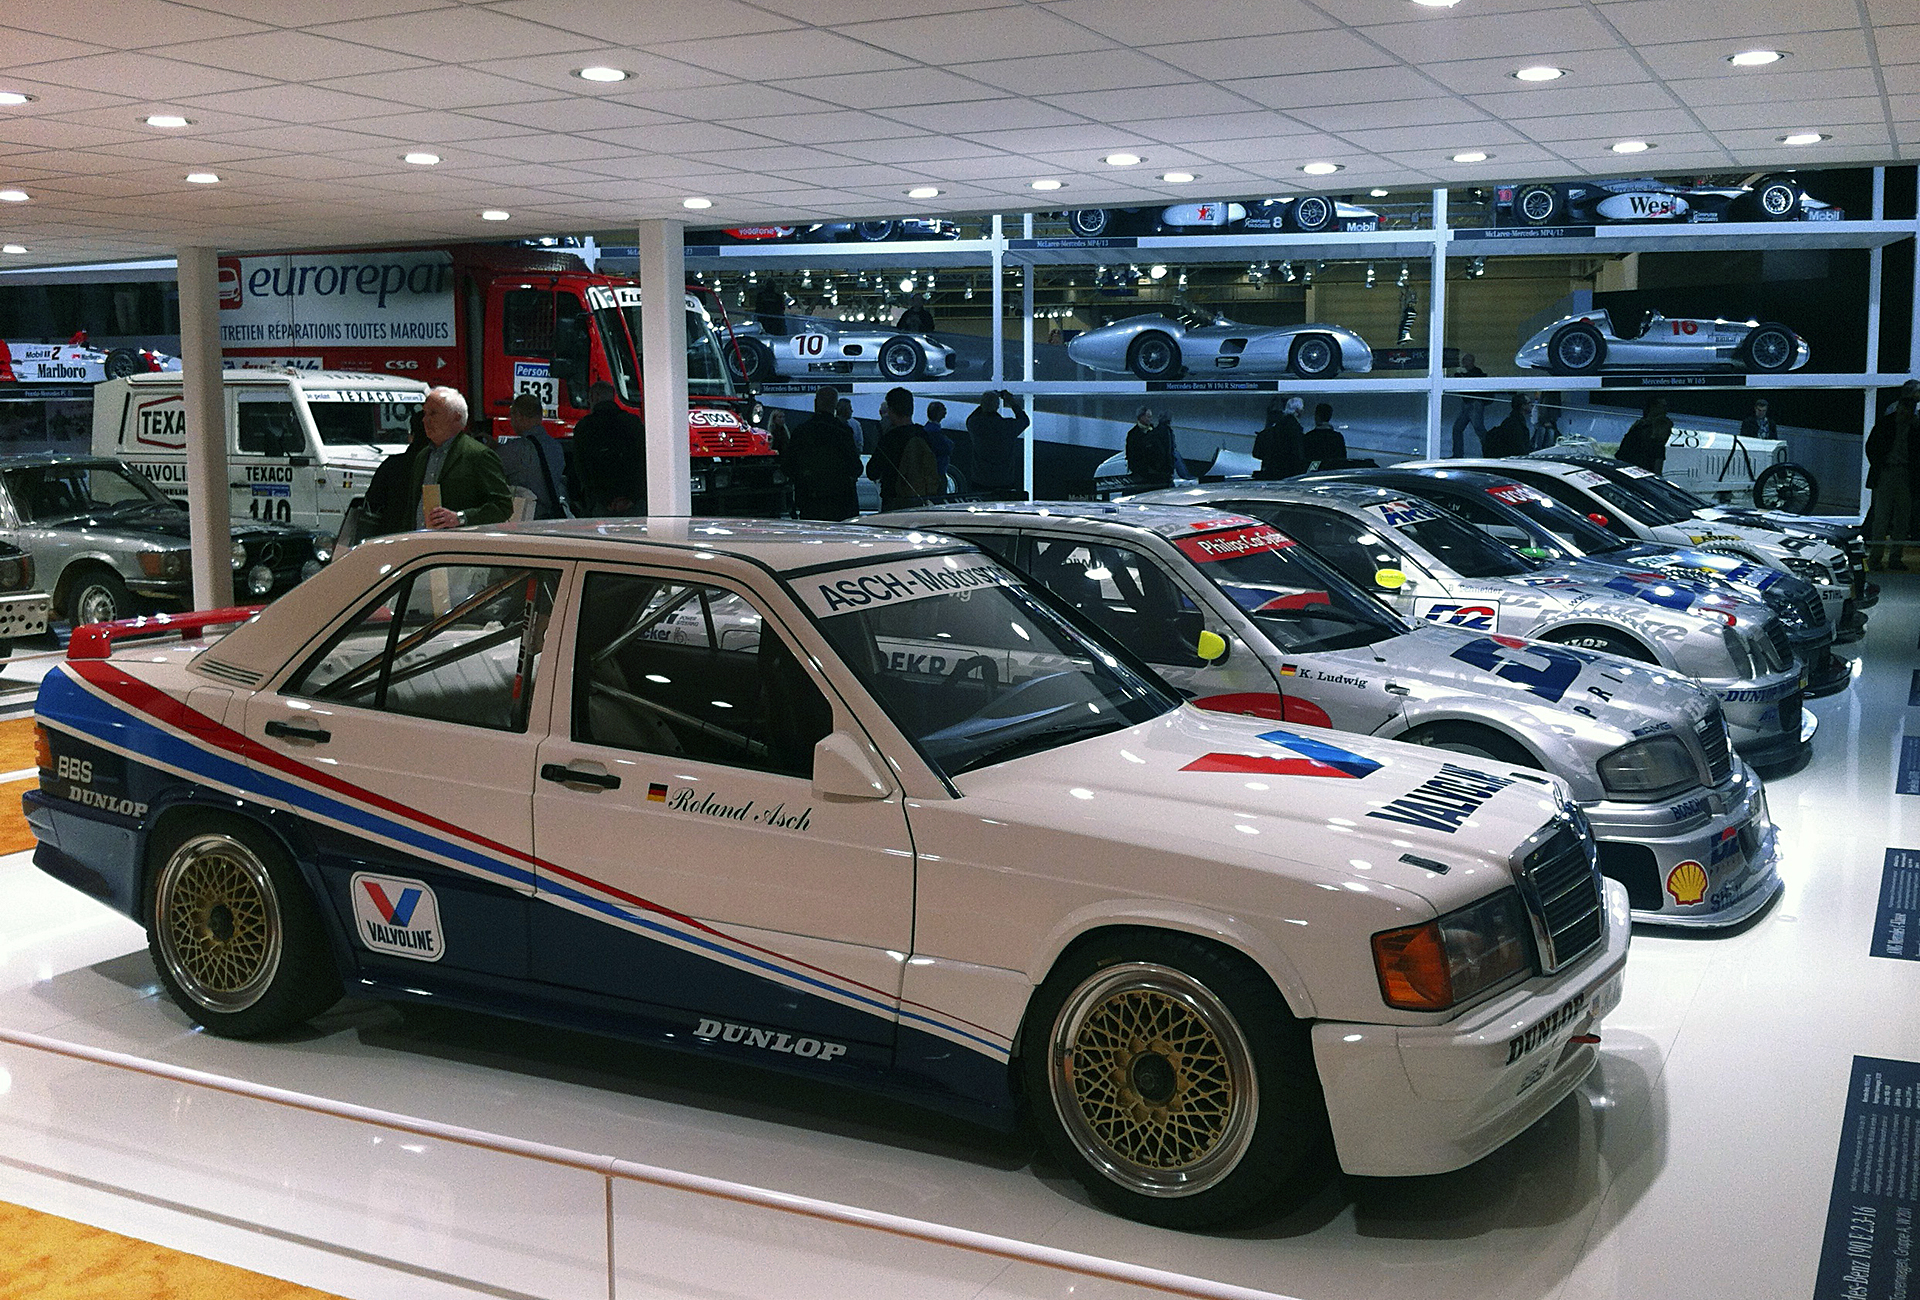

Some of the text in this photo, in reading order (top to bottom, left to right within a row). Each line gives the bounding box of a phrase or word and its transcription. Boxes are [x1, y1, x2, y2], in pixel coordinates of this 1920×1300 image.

[1273, 216, 1283, 228] 8
[1346, 221, 1376, 233] Mobil
[249, 262, 454, 309] eurorepar
[268, 321, 342, 340] RÉPARATIONS
[344, 322, 388, 340] TOUTES
[390, 321, 449, 340] MARQUES
[1671, 320, 1698, 335] 16
[52, 346, 61, 360] 2
[795, 335, 824, 356] 10
[37, 363, 87, 379] Marlboro
[385, 359, 419, 370] CSG
[517, 365, 551, 378] Person
[337, 391, 395, 402] TEXACO
[704, 411, 735, 425] TOOLS
[1669, 428, 1700, 448] 28
[245, 466, 293, 482] TEXACO
[1299, 667, 1368, 689] K. Ludwig
[1643, 721, 1673, 737] AMG
[58, 755, 93, 784] BBS
[68, 785, 149, 818] DUNLOP
[668, 786, 813, 831] Roland Asch
[366, 919, 434, 952] VALVOLINE
[1506, 991, 1589, 1067] DUNLOP
[692, 1018, 848, 1061] DUNLOP
[1851, 1205, 1878, 1234] 2.3-16
[1849, 1233, 1874, 1242] E
[1848, 1242, 1873, 1259] 190
